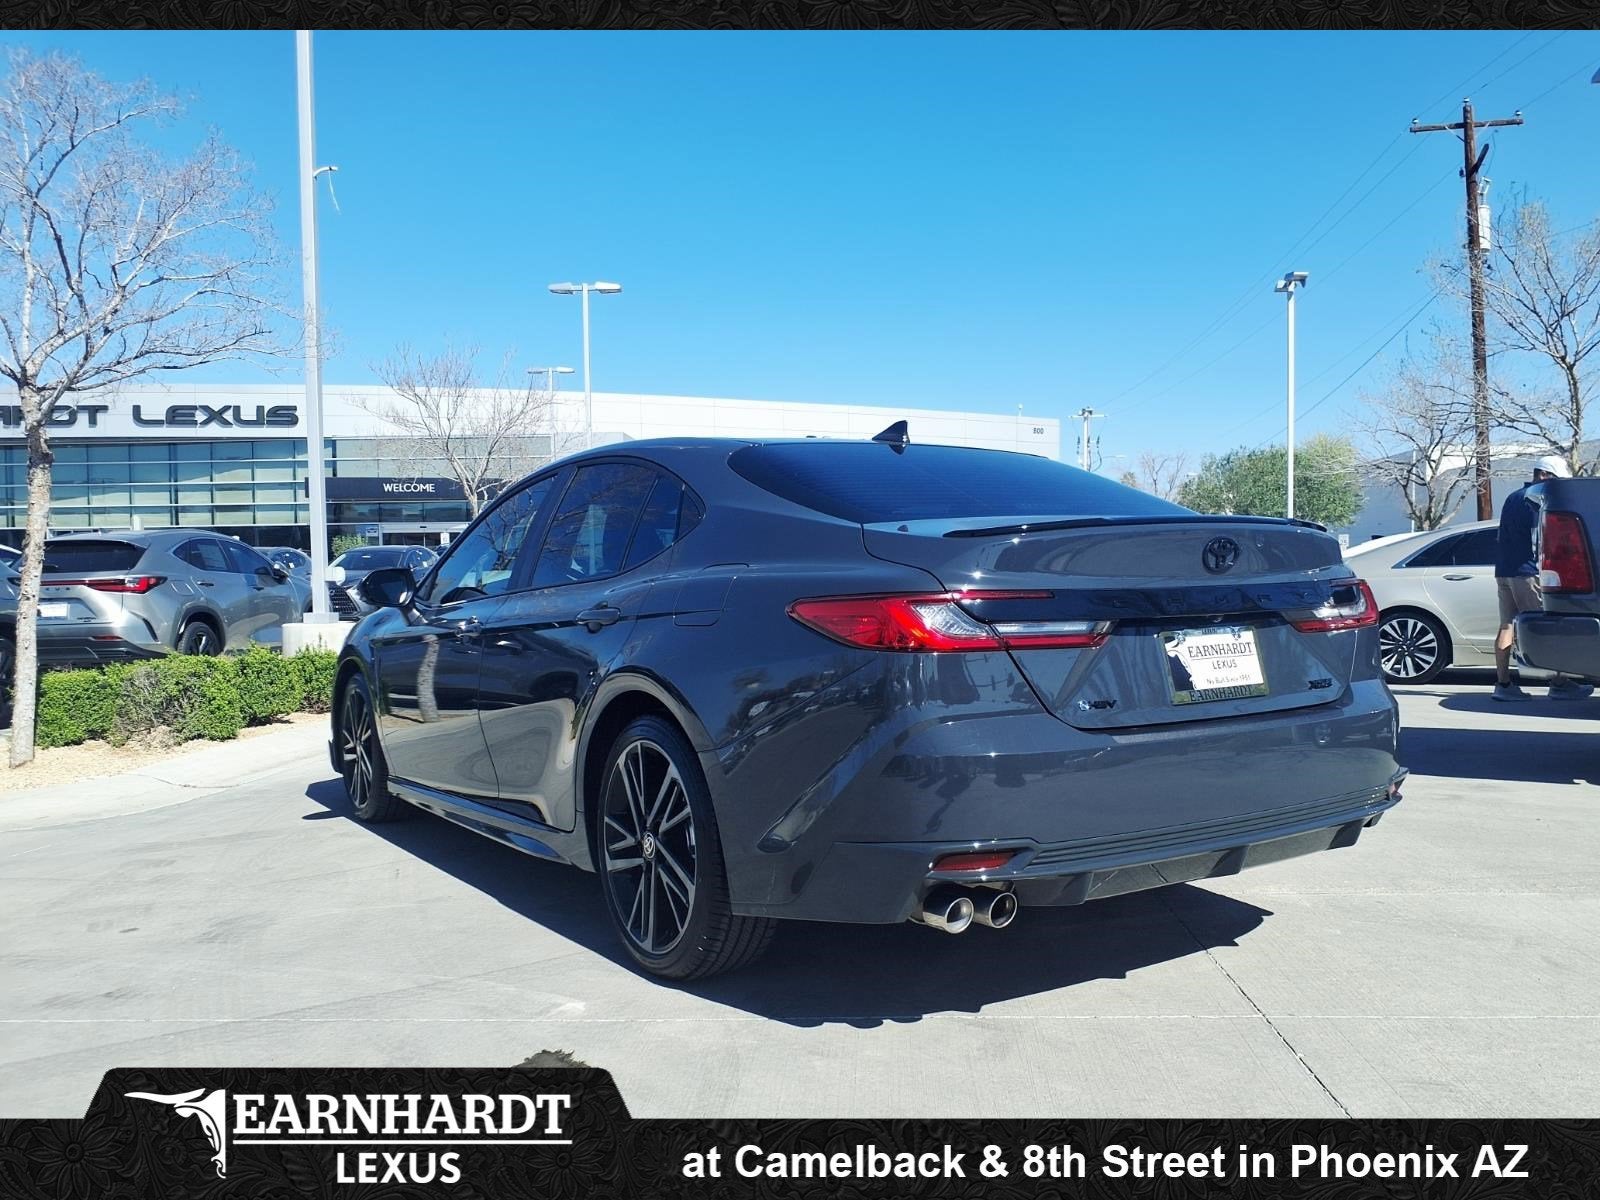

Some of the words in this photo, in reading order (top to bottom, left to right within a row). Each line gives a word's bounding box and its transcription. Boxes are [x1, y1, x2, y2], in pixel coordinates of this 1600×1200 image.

[133, 405, 299, 426] LEXUS
[383, 483, 436, 493] WELCOME
[1187, 642, 1252, 658] EARNHARDT
[1212, 659, 1238, 669] LEXUS
[1189, 685, 1252, 702] EARNHARDT
